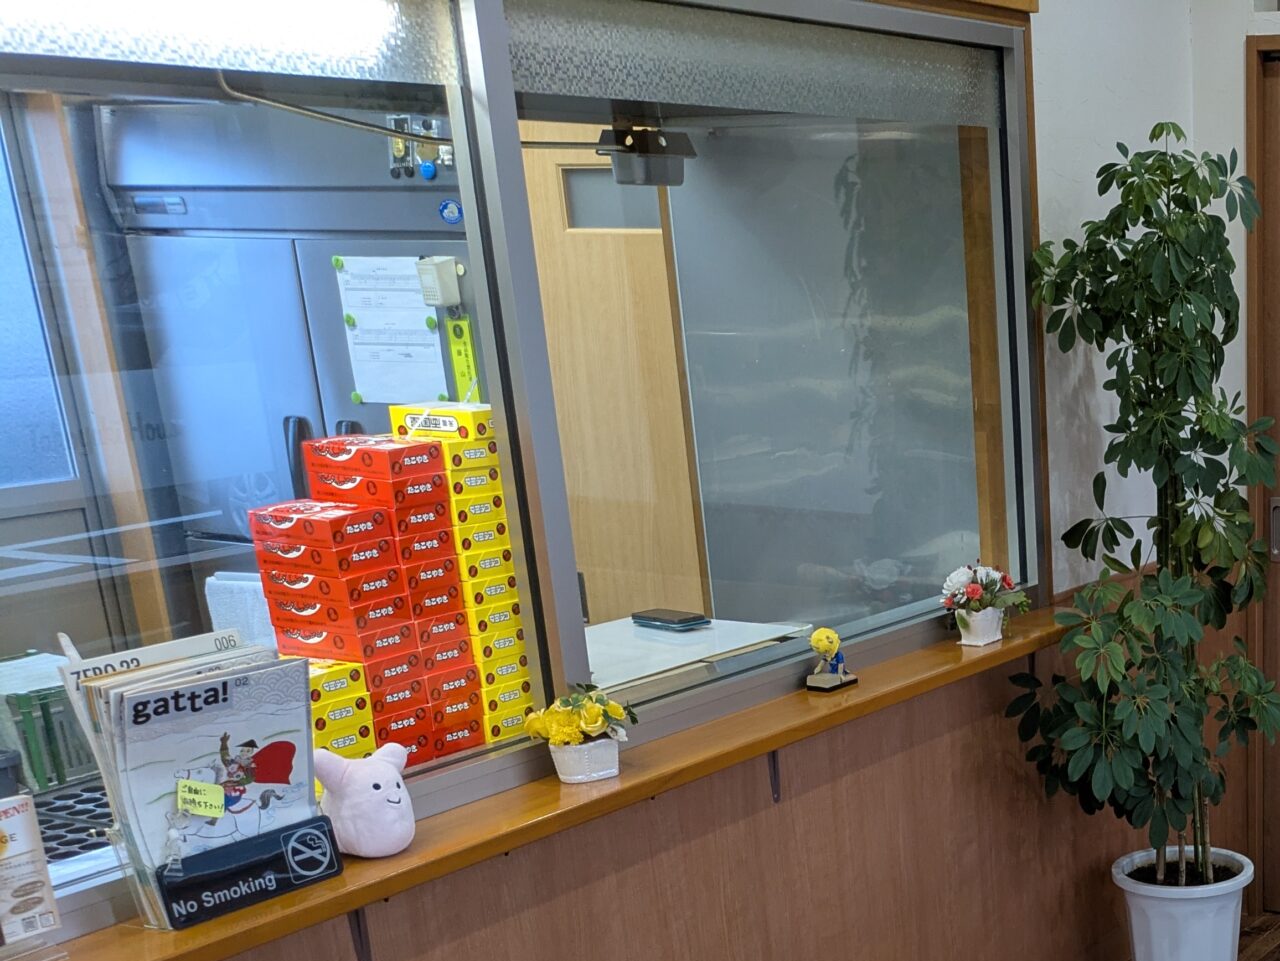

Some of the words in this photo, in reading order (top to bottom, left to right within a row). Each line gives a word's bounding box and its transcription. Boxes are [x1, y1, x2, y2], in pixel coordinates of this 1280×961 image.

[404, 455, 429, 465] たこやき
[407, 483, 432, 494] たこやき
[410, 513, 435, 523] たこやき
[346, 522, 374, 534] たこやき
[414, 539, 439, 551] たこやき
[352, 549, 379, 561] たこやき
[420, 566, 444, 579] たこやき
[363, 579, 388, 591] たこやき
[424, 594, 448, 608] たこやき
[369, 606, 394, 618] たこやき
[432, 620, 456, 634] たこやき
[214, 635, 236, 651] 006
[376, 635, 401, 648] たこやき
[436, 647, 460, 661] たこやき
[384, 664, 409, 677] たこやき
[443, 678, 466, 690] たこやき
[132, 682, 229, 725] gatta!
[235, 676, 248, 687] 02
[386, 690, 411, 703] たこやき
[446, 702, 469, 713] たこやき
[391, 717, 416, 730] たこやき
[446, 729, 470, 741] たこやき
[172, 899, 198, 918] No
[201, 875, 277, 908] Smoking
